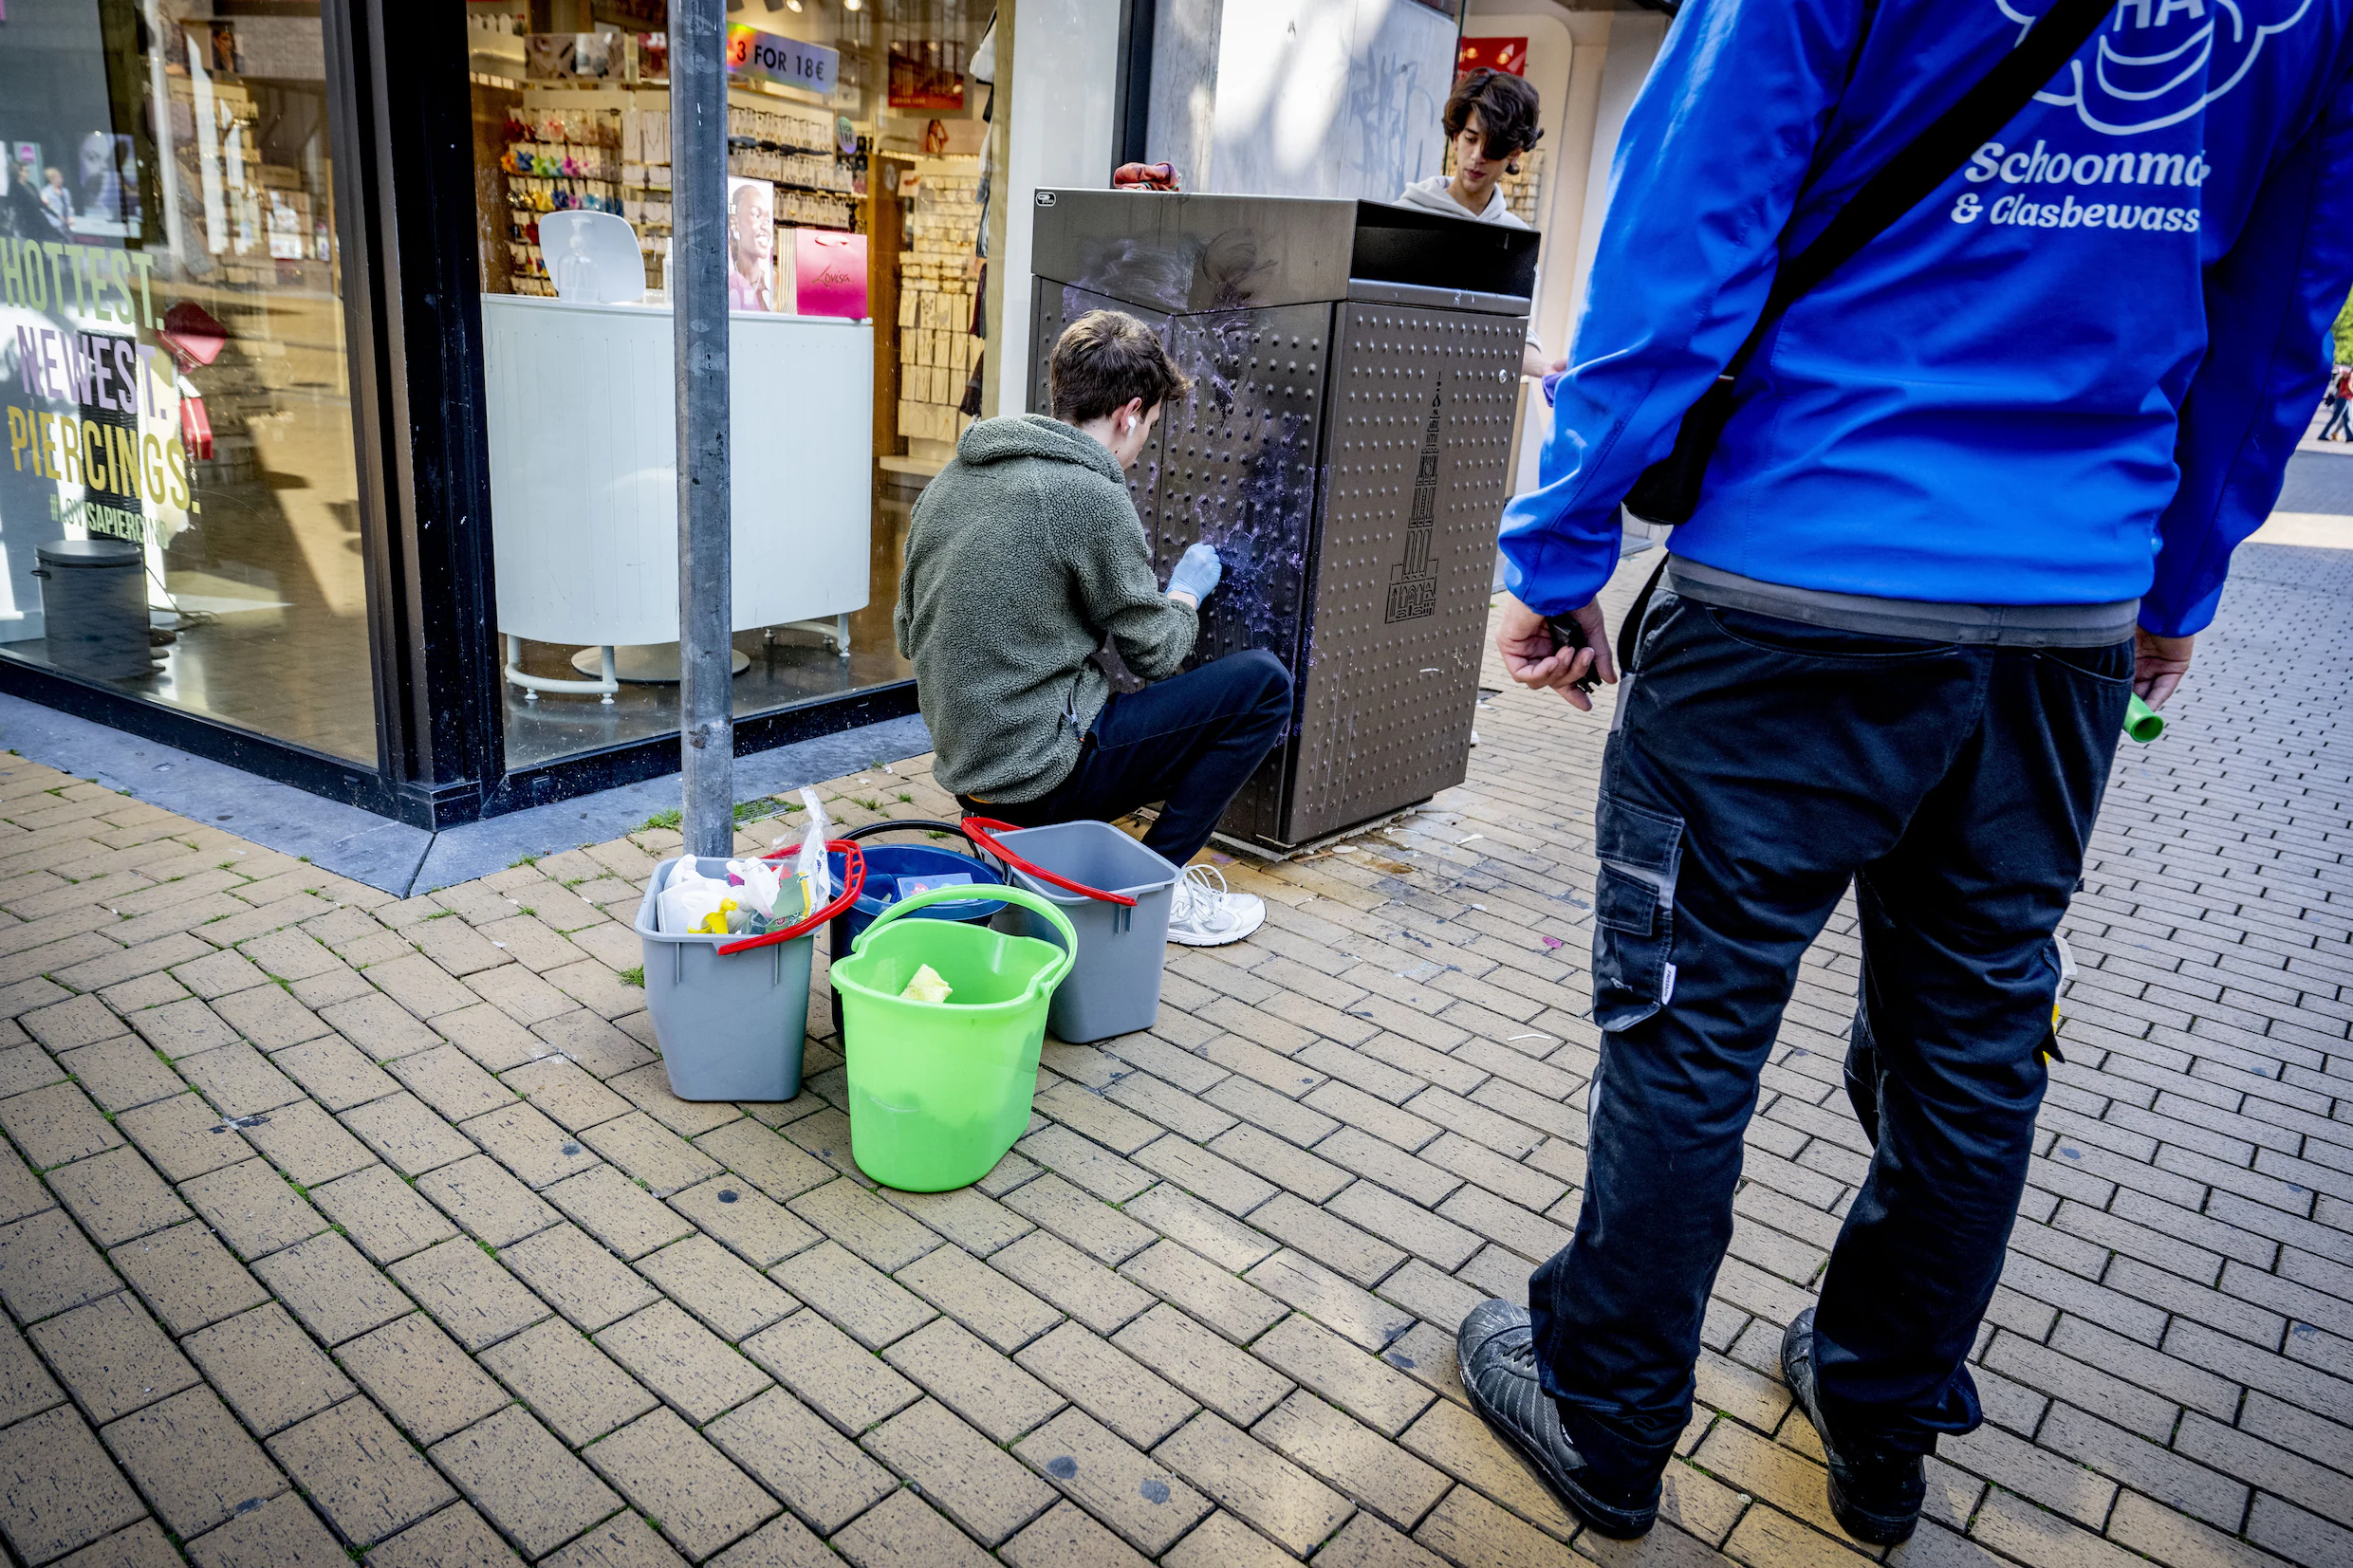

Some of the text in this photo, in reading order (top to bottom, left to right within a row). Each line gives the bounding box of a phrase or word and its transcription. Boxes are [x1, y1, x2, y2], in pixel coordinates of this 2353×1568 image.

[736, 41, 824, 81] 3 FOR 18€
[1964, 138, 2212, 188] Schoonma
[1951, 193, 1984, 224] &
[0, 237, 165, 331] HOTTEST.
[811, 263, 852, 288] Lovisa
[16, 324, 168, 420] NEWEST.
[7, 405, 201, 514] PIERCINGS.
